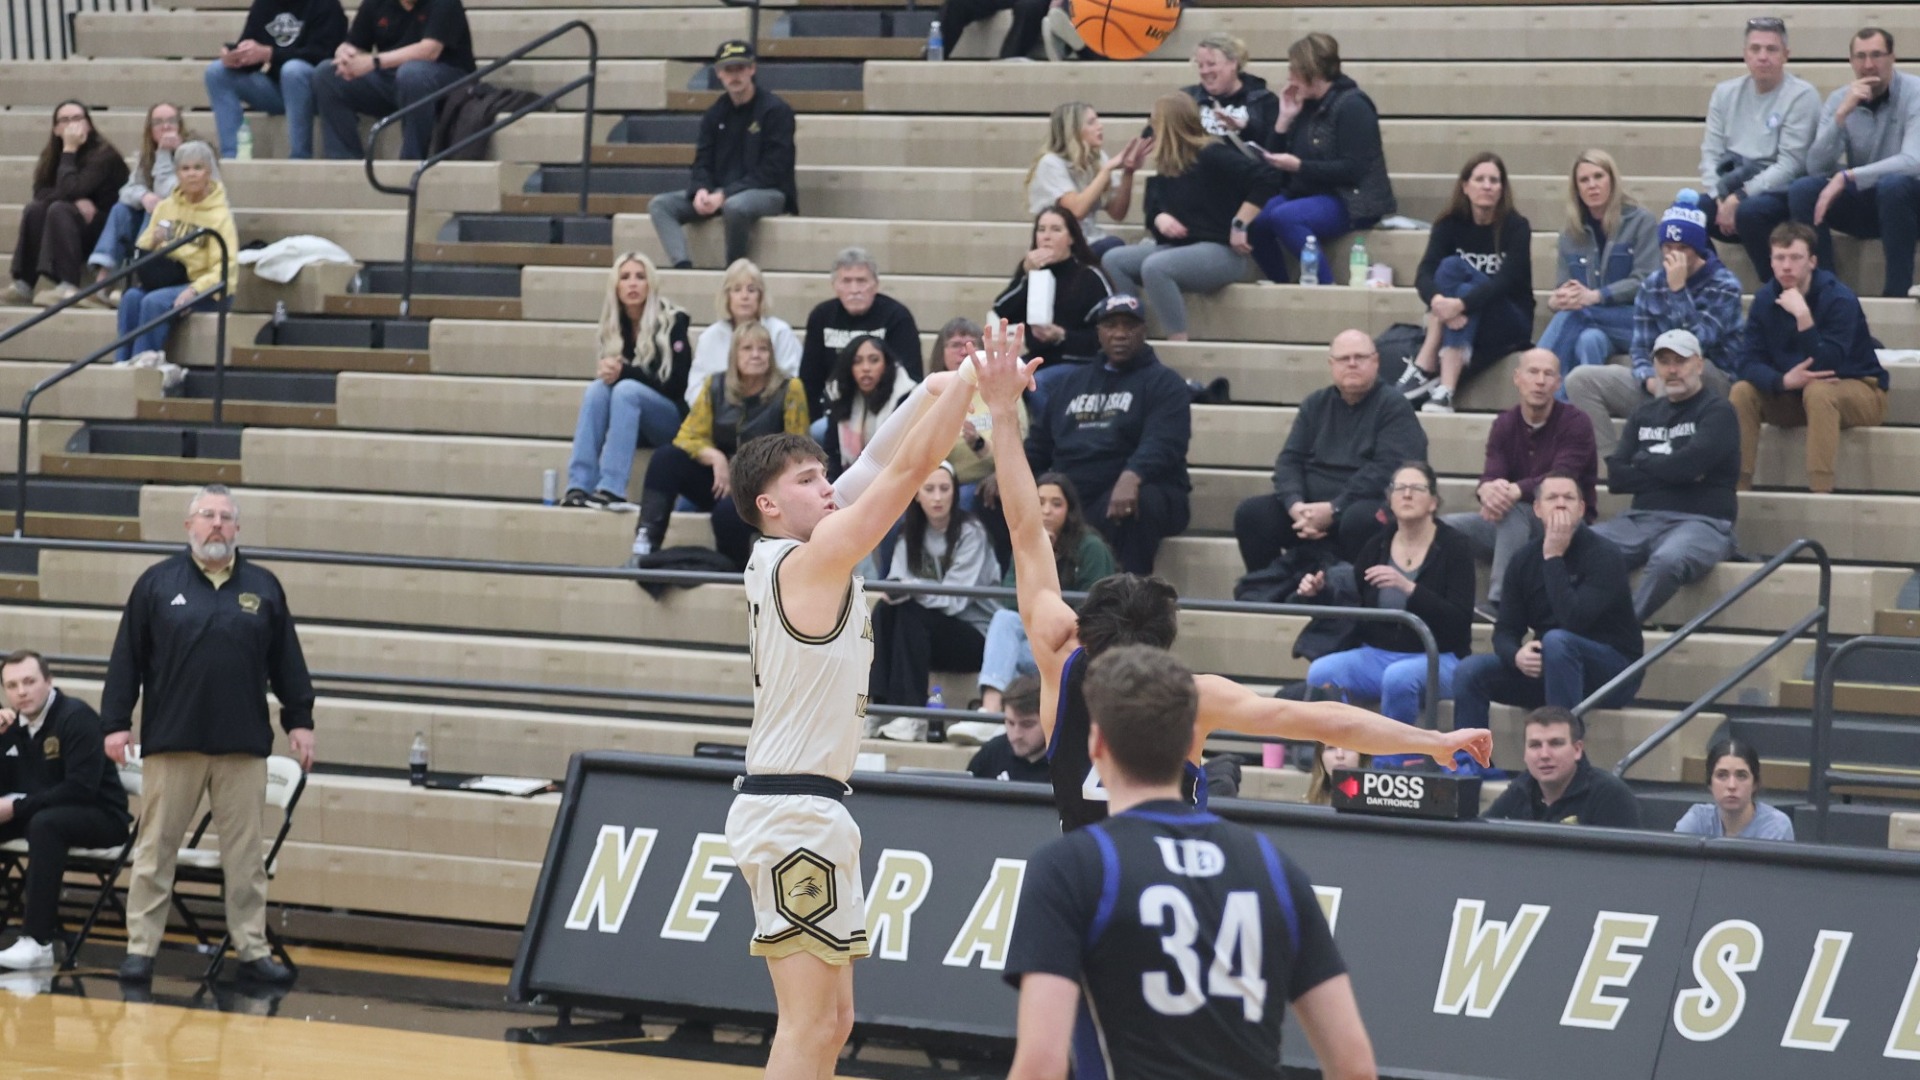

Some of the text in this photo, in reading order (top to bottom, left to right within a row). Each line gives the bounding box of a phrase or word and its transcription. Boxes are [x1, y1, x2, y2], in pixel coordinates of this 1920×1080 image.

[1363, 773, 1424, 799] POSS
[1366, 797, 1420, 809] DAKTRONICS
[1139, 884, 1267, 1023] 34
